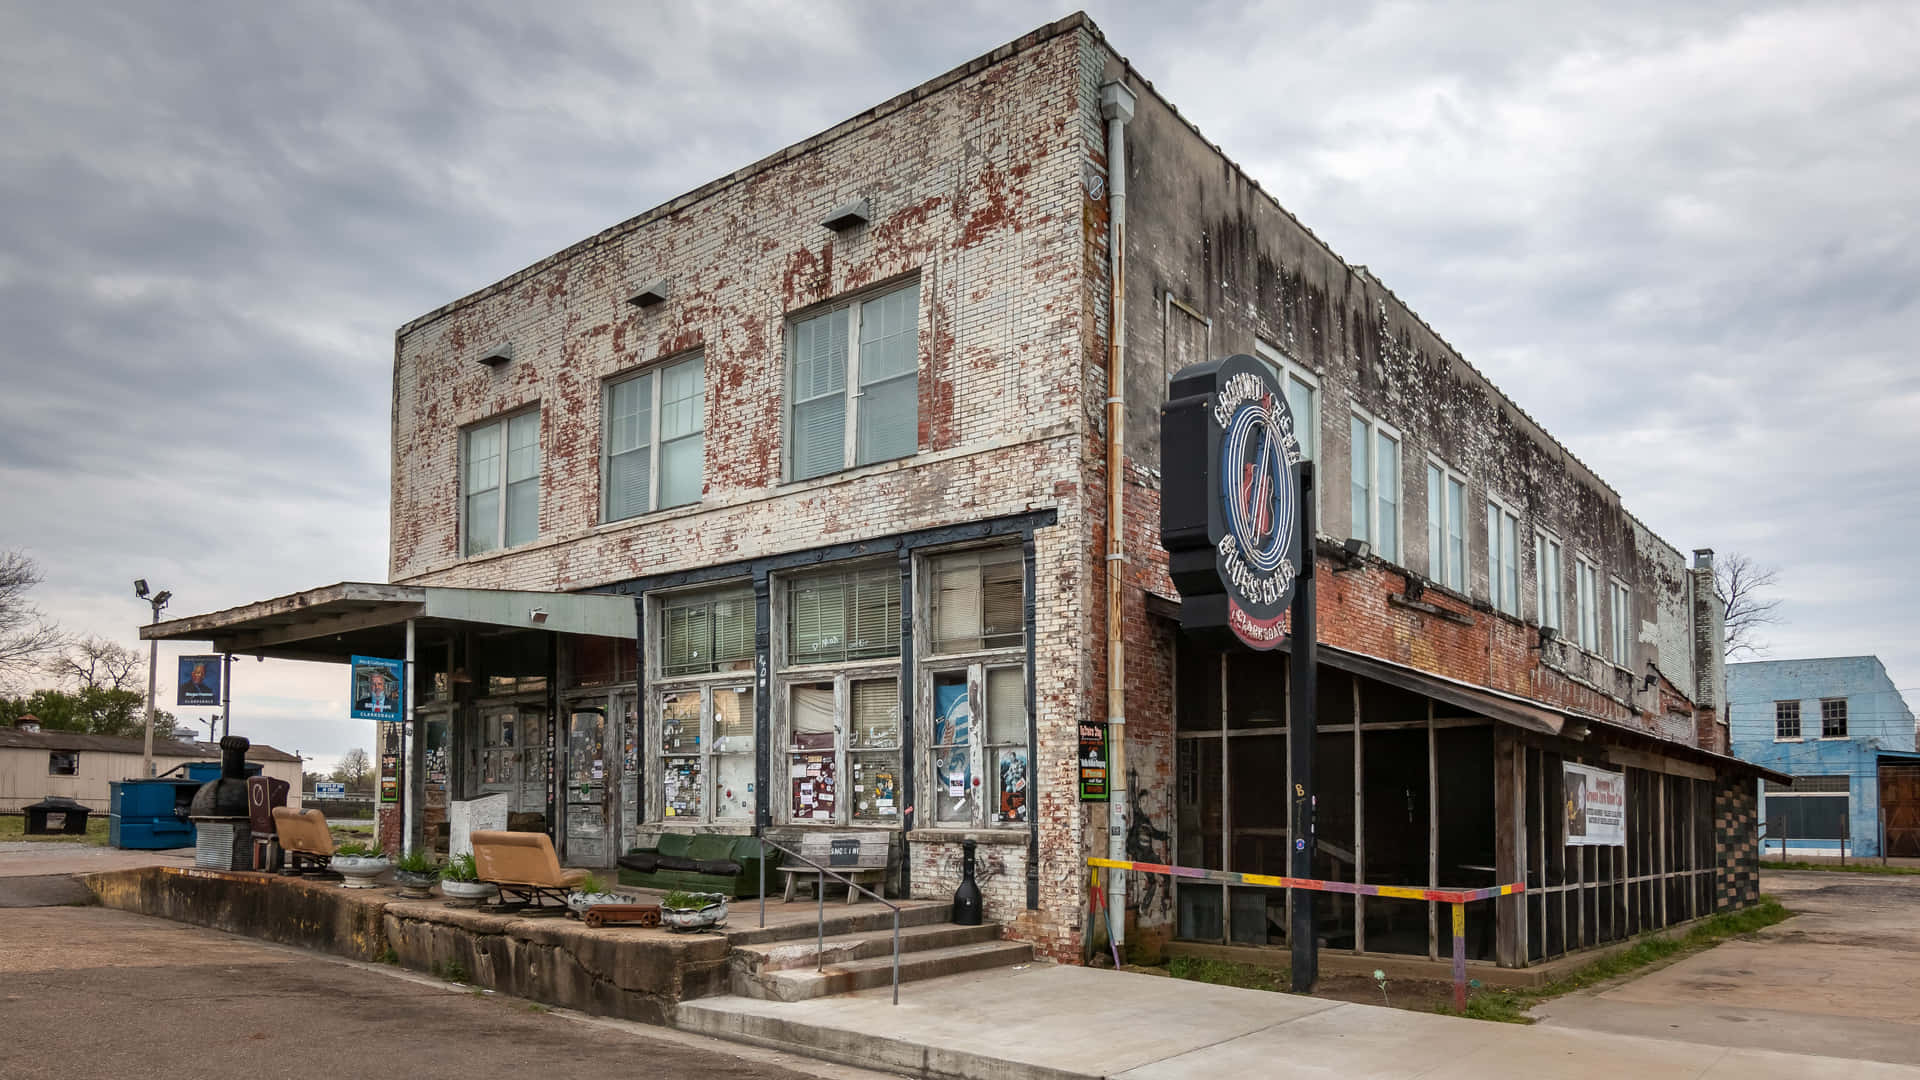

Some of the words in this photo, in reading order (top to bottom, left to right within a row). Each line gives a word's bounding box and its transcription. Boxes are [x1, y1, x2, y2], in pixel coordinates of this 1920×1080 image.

[1214, 372, 1264, 429] GROUND
[1219, 534, 1262, 604] BLUES
[1262, 558, 1295, 605] CLUB
[360, 711, 395, 719] CLARKSDALE
